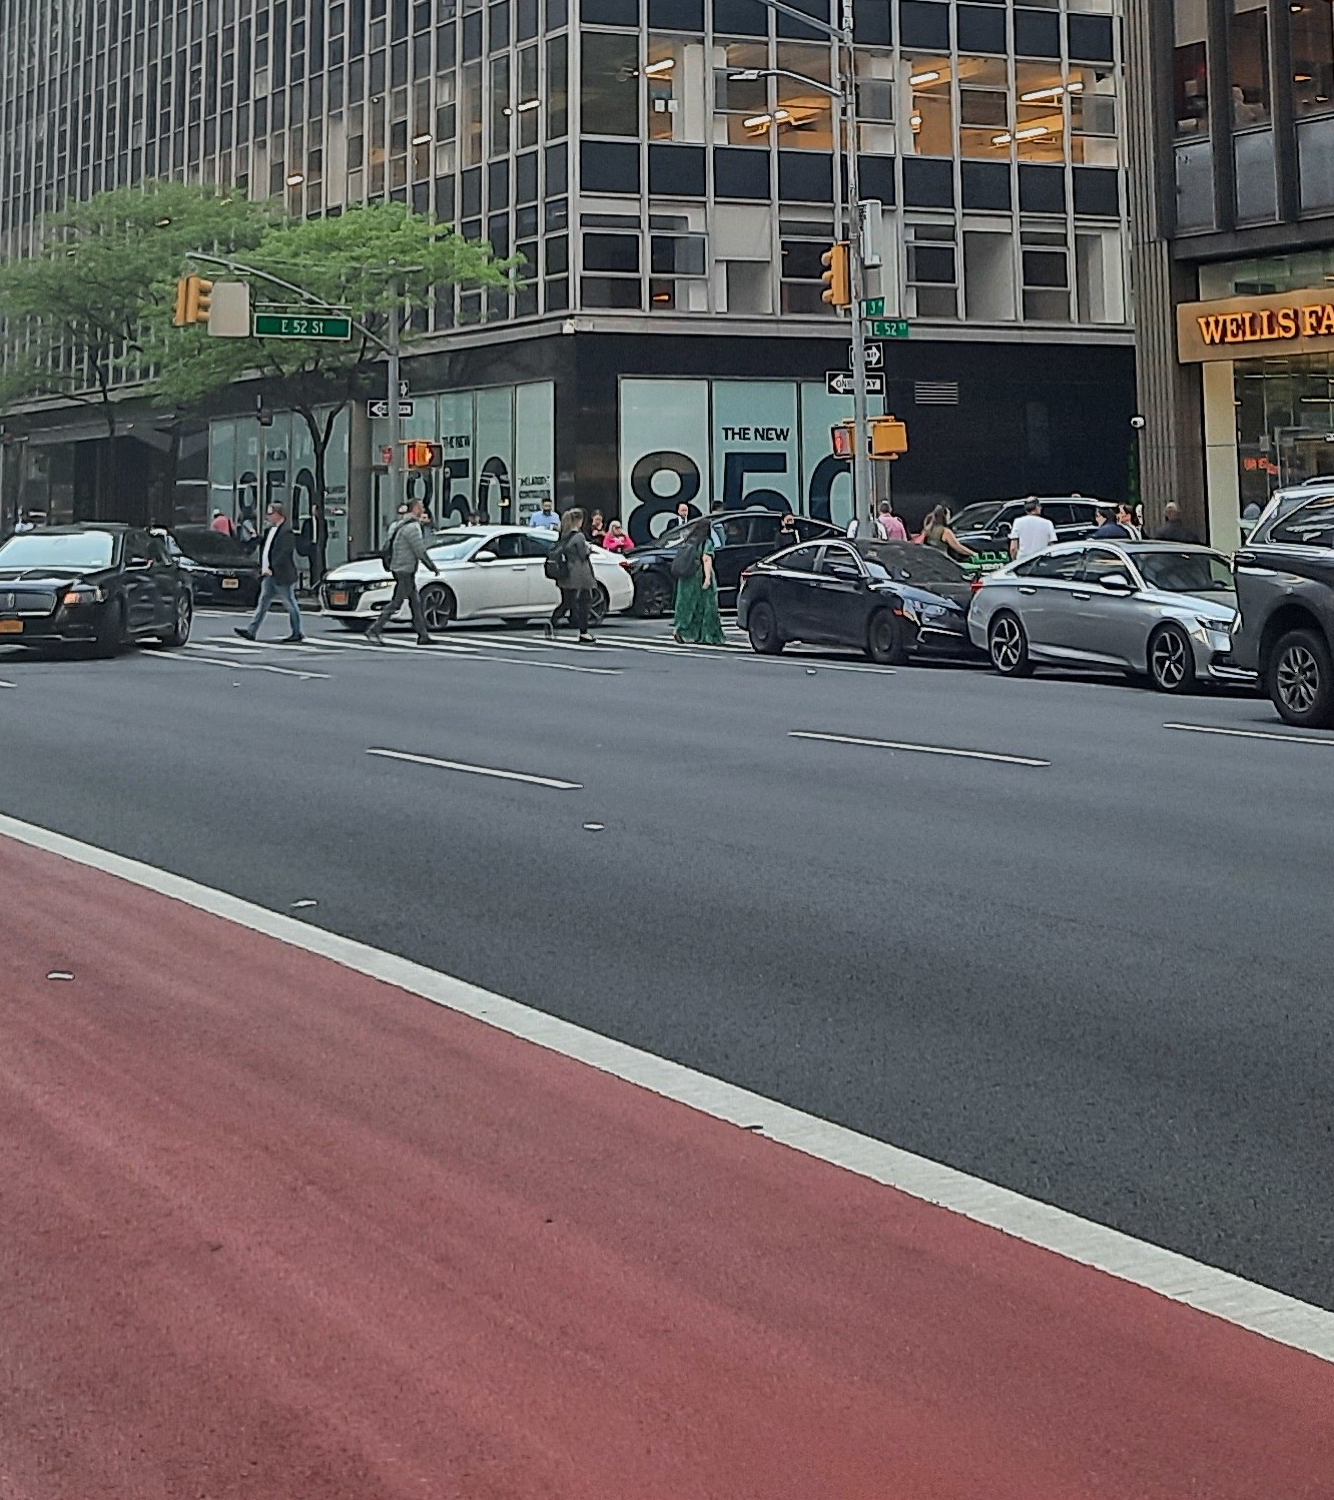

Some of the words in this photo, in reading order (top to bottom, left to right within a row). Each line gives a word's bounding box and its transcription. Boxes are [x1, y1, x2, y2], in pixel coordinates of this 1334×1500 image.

[281, 321, 289, 333] E
[293, 320, 308, 334] 52
[312, 322, 325, 334] St
[873, 322, 880, 335] E
[884, 323, 897, 336] 52
[1198, 308, 1298, 345] WELLS
[722, 427, 750, 441] THE
[754, 427, 790, 441] NEW
